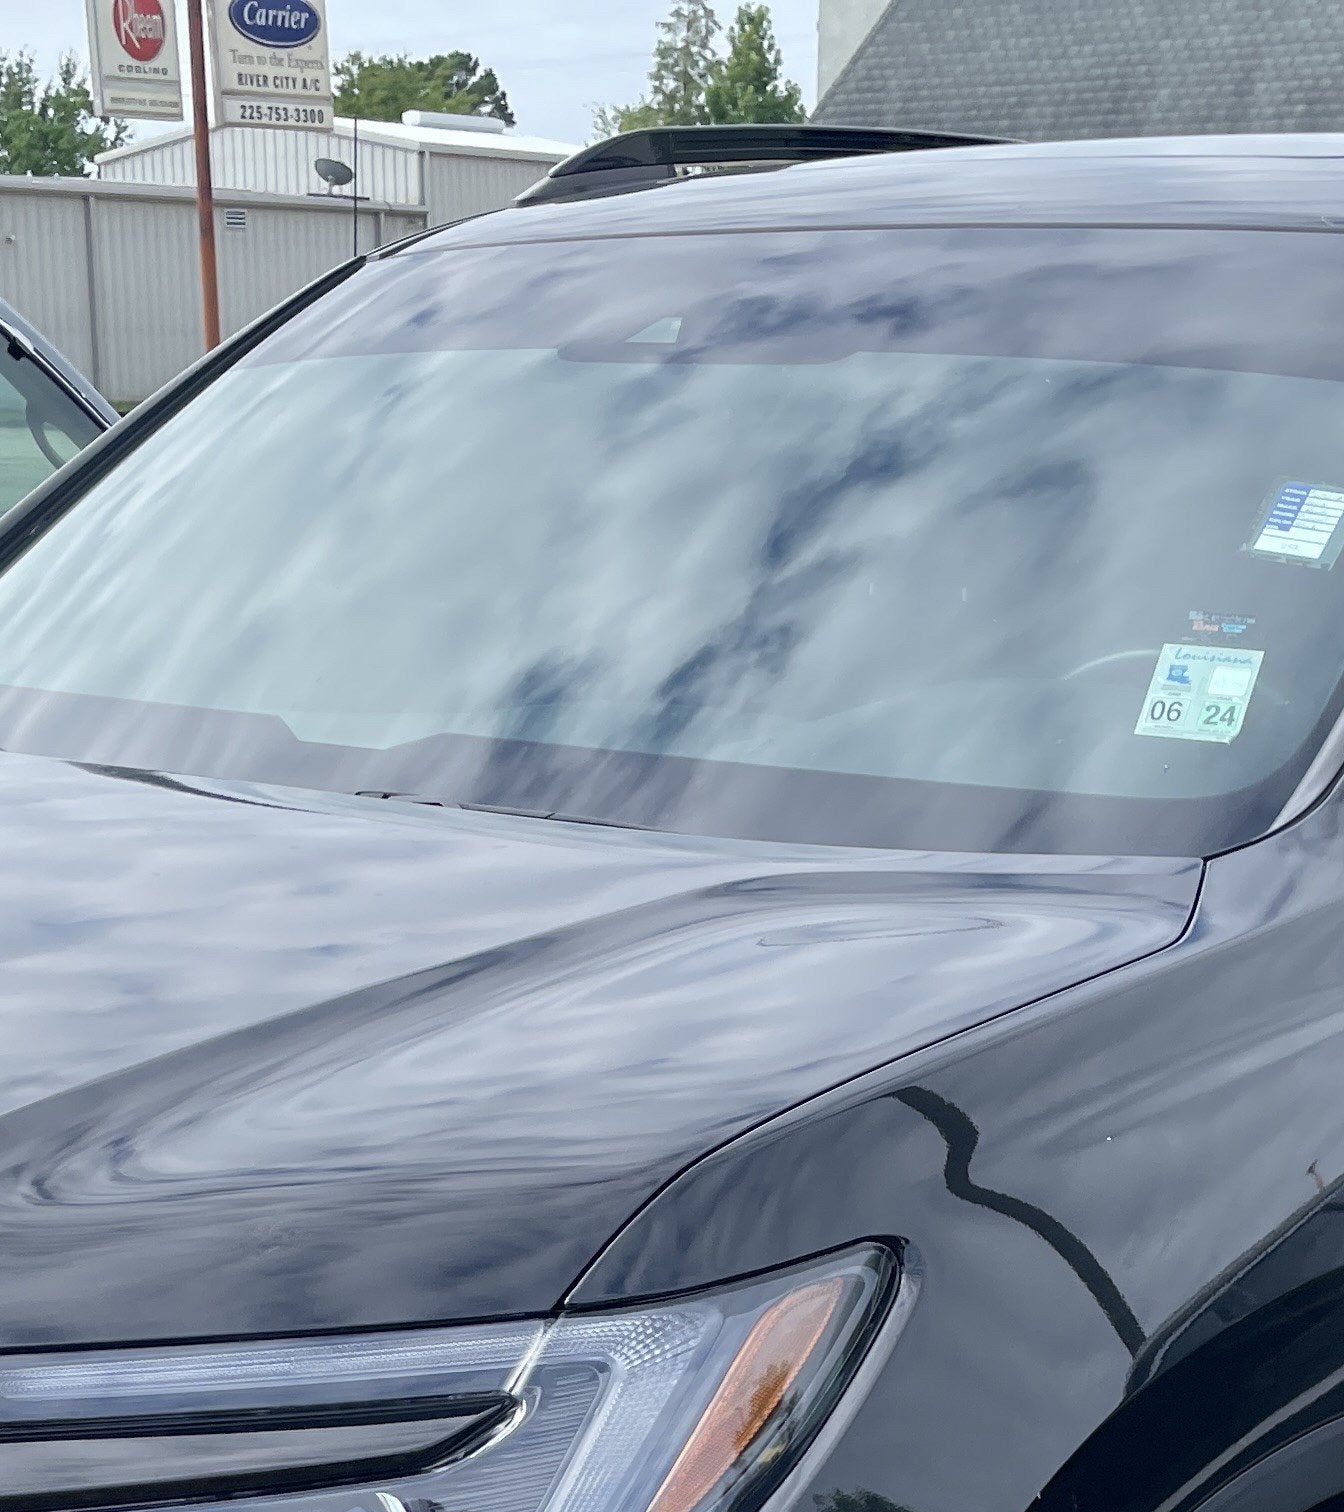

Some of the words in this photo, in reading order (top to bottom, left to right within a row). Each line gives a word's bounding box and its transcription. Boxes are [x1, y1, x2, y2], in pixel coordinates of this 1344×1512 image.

[243, 1, 309, 29] Carrier
[118, 64, 168, 76] COOLING
[237, 72, 269, 88] RIVER
[273, 75, 298, 90] CITY
[302, 77, 320, 91] A/C
[240, 104, 324, 124] 225-753-3300
[1174, 647, 1253, 665] Louisiana
[1150, 700, 1184, 722] 06
[1203, 704, 1236, 727] 24
